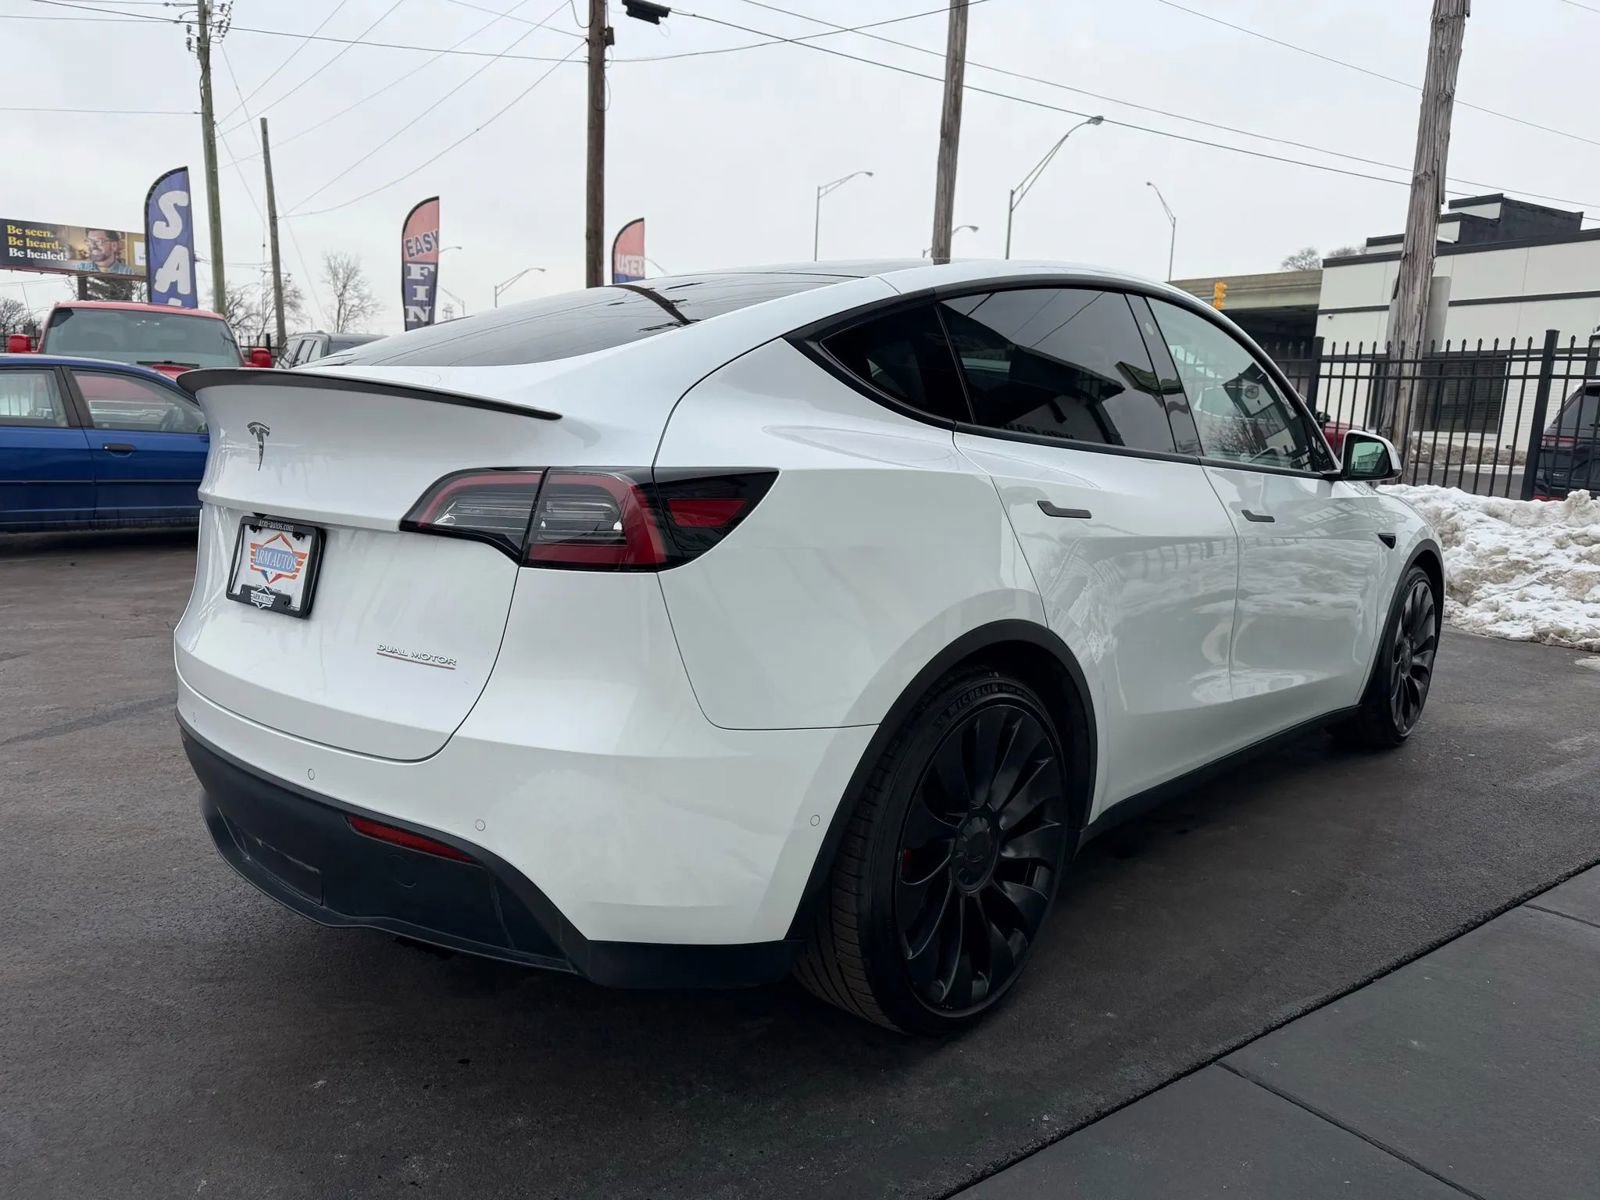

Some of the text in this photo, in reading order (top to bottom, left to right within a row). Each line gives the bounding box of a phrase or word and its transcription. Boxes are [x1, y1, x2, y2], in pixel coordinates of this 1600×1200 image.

[7, 224, 54, 239] Be seen.
[8, 236, 63, 251] Be heard.
[153, 190, 191, 305] SA
[405, 230, 439, 258] EASY
[9, 247, 68, 262] Be healed.
[377, 644, 457, 666] DUAL MOTOR
